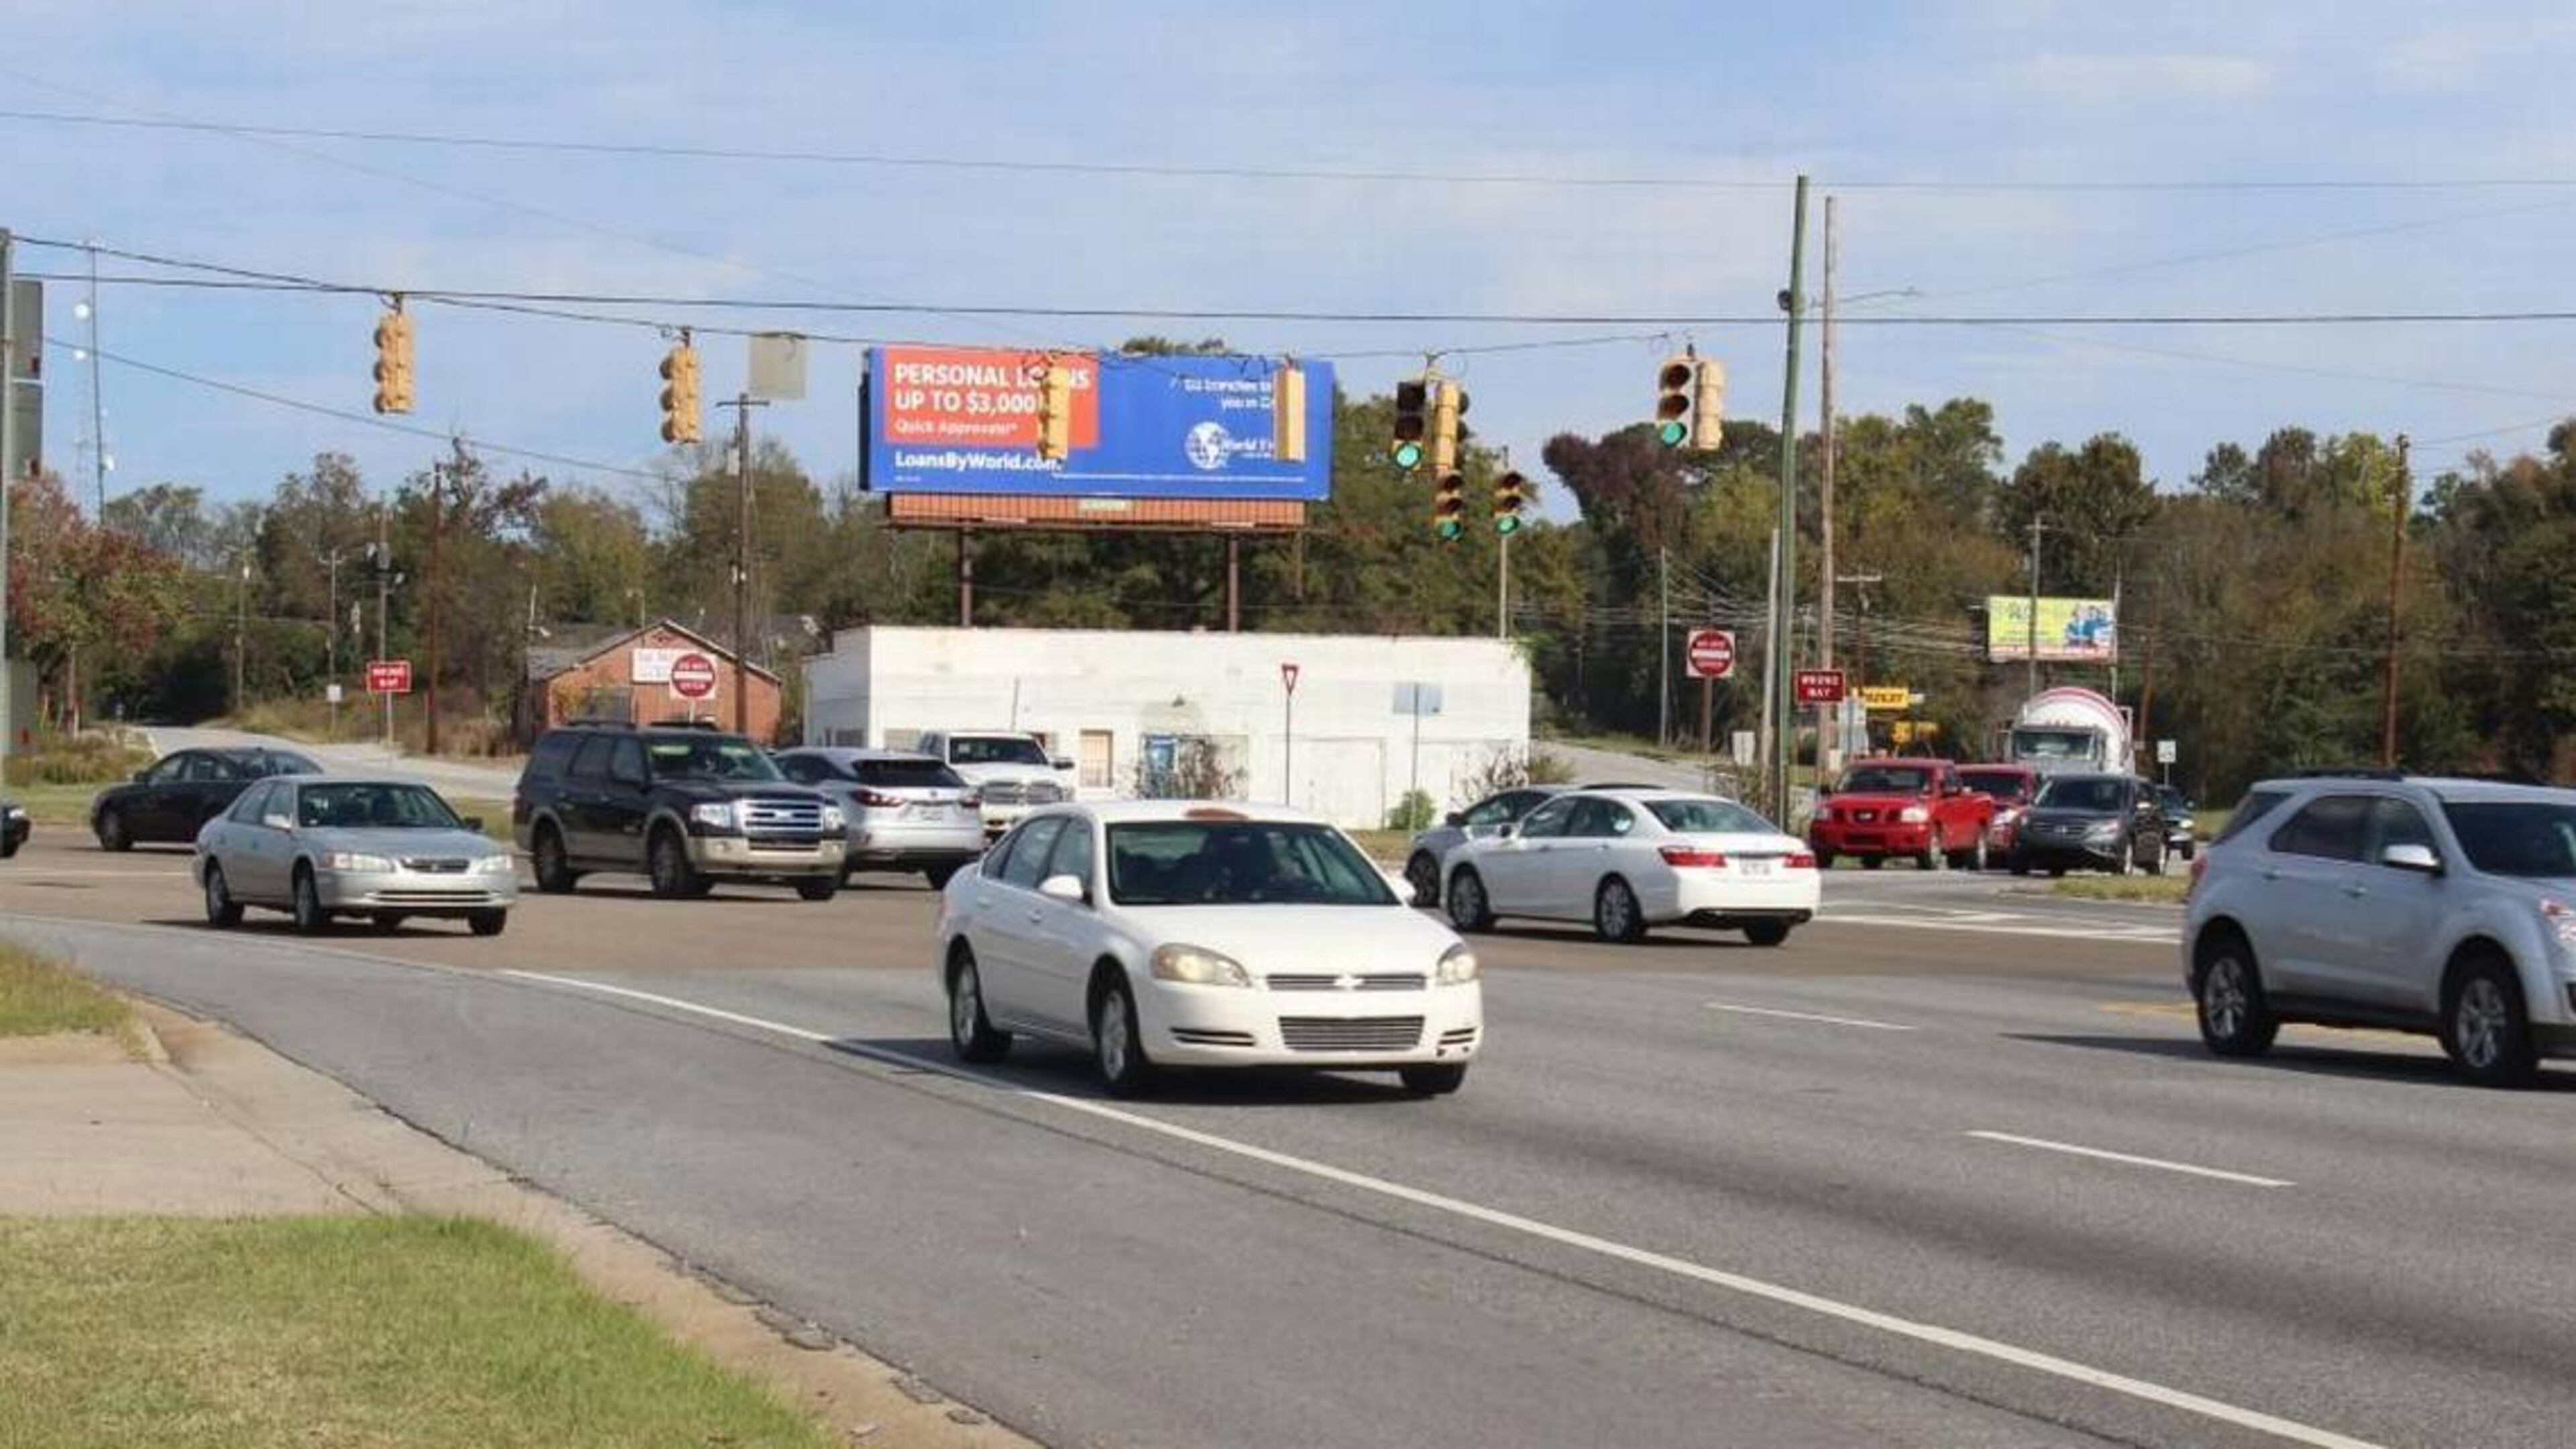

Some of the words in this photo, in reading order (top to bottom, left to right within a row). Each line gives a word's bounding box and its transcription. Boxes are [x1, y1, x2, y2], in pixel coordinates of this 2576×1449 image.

[895, 363, 1010, 387] PERSONAL
[895, 390, 924, 410] UP
[931, 391, 960, 412] TO
[966, 392, 1036, 415] $3,000
[894, 418, 933, 434] Quick
